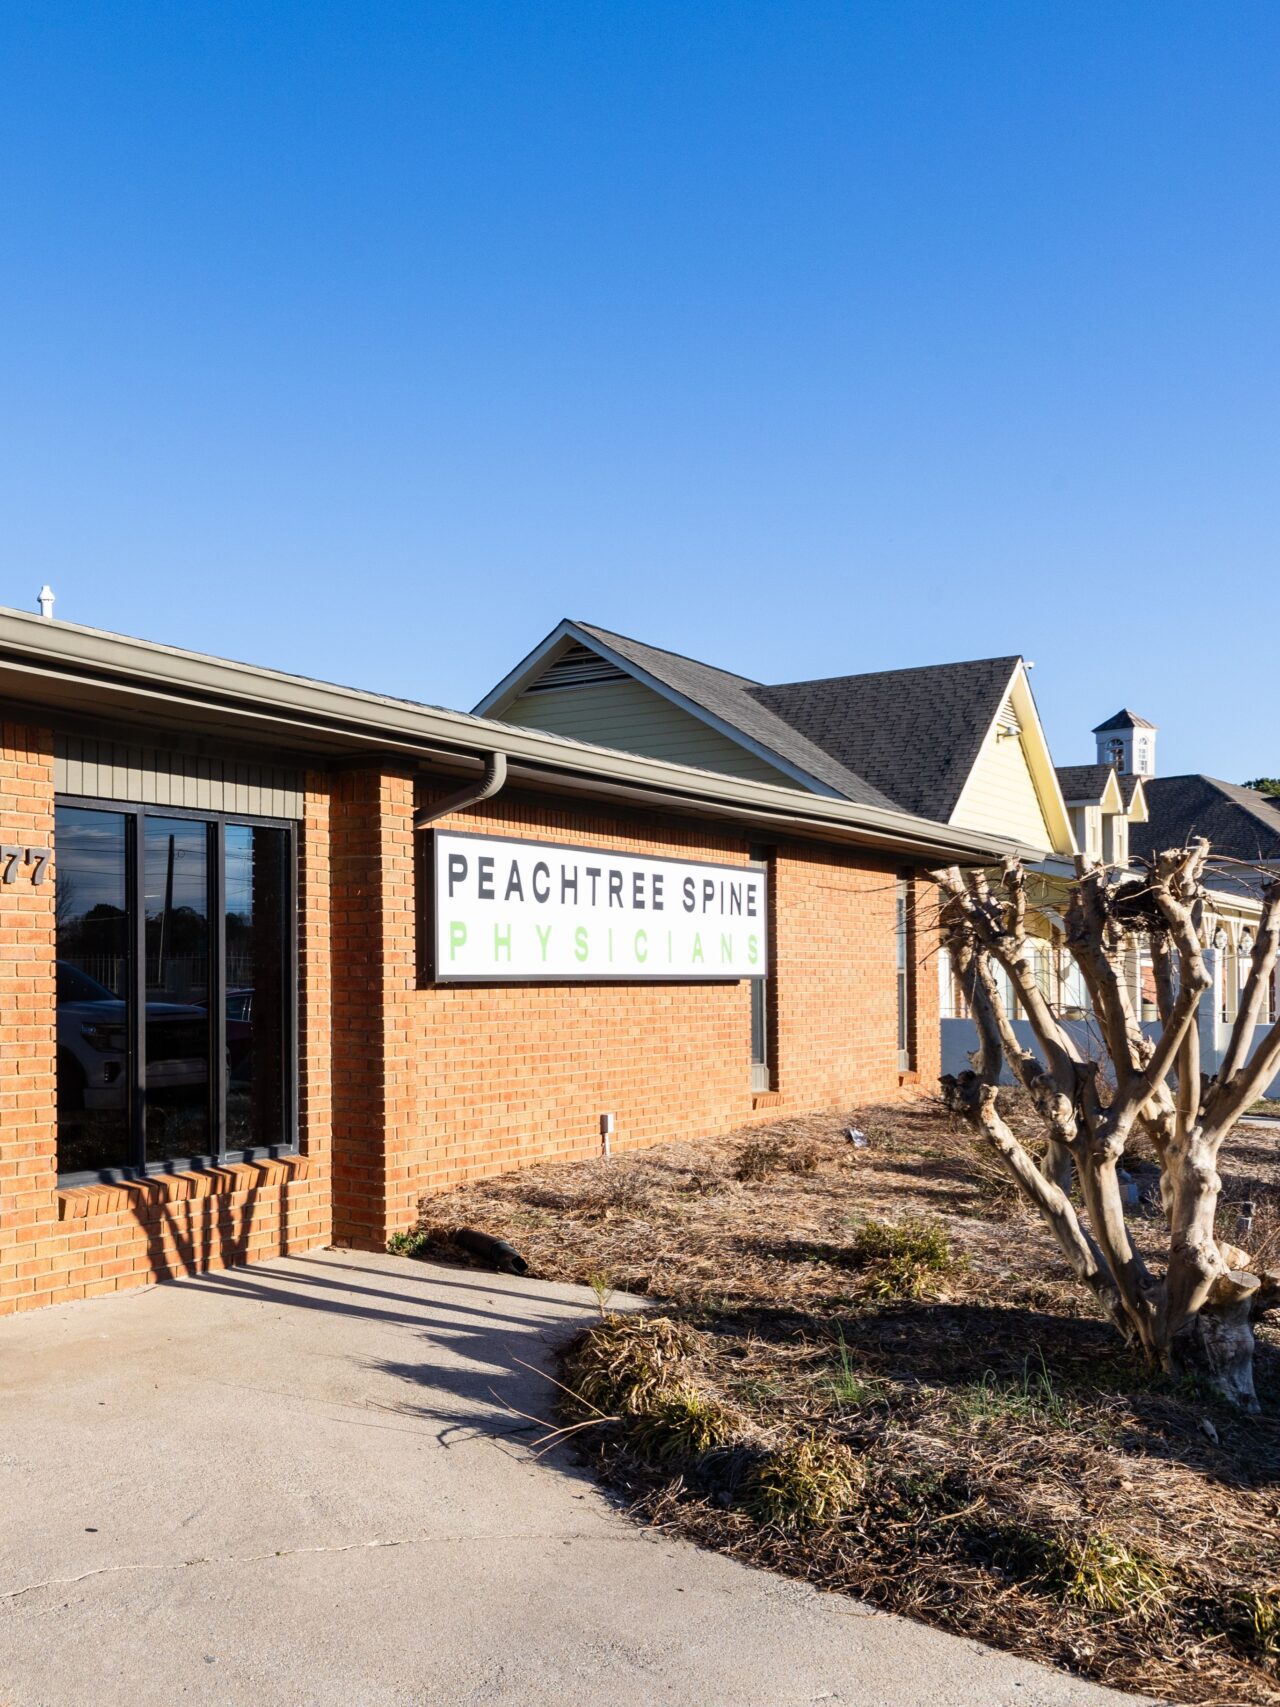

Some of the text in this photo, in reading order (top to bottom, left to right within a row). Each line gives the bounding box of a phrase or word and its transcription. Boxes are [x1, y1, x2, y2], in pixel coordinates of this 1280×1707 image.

[448, 853, 757, 917] PEACHTREE SPINE
[449, 920, 759, 965] PHYSICIANS
